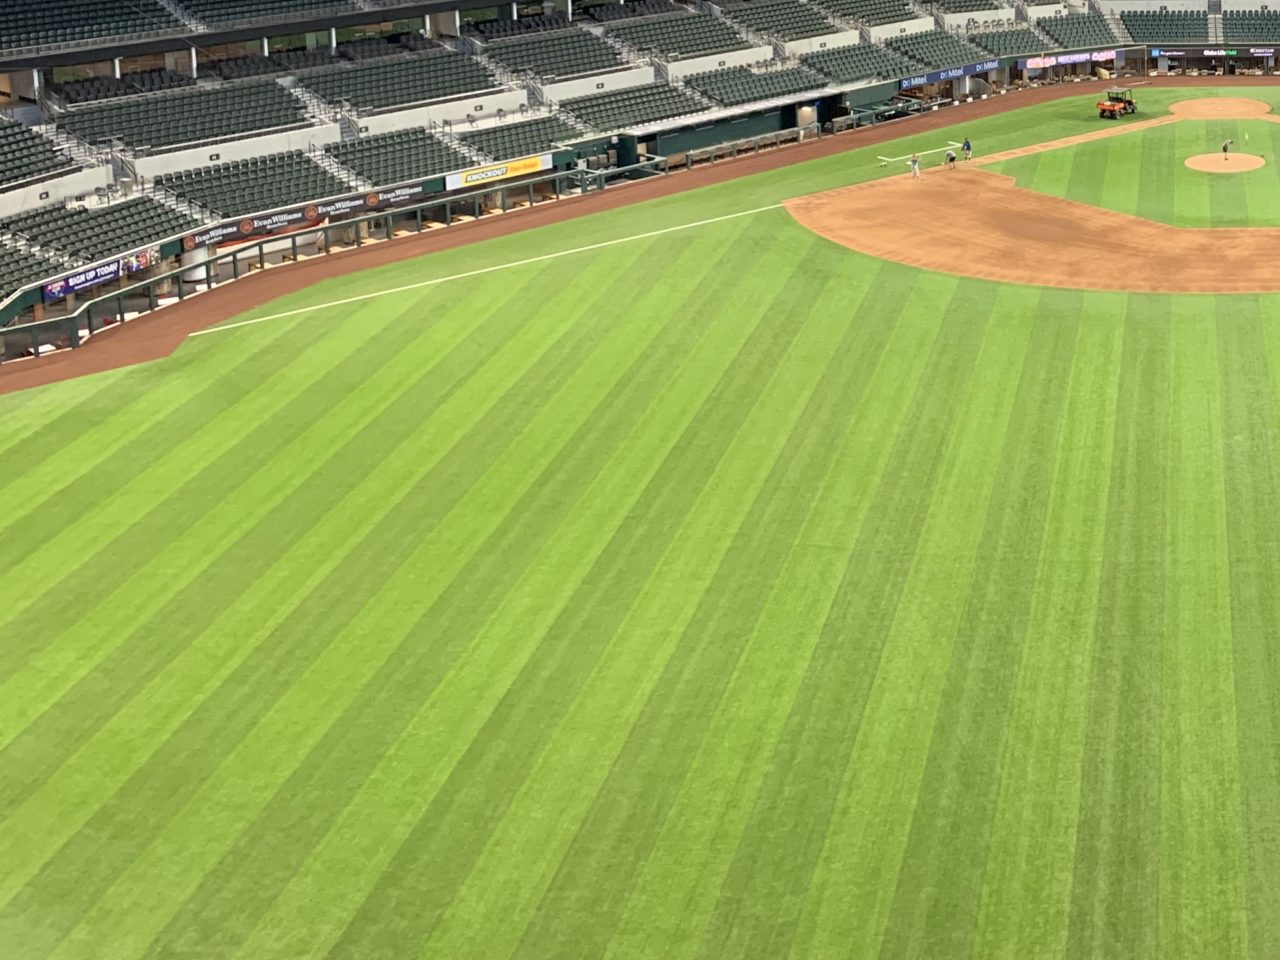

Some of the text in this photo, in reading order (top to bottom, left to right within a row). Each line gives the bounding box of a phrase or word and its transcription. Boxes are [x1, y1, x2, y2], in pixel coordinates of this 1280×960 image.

[948, 67, 963, 77] Mitel
[983, 59, 999, 70] Mitel
[911, 75, 927, 86] Mitel
[465, 167, 508, 183] KNOCKOUT
[378, 186, 423, 201] Evan Williams
[318, 198, 364, 214] Evan Williams
[253, 212, 302, 228] Evan Williams
[195, 226, 237, 243] Evan Williams
[68, 272, 86, 286] SIGN
[86, 270, 96, 281] UP
[96, 262, 119, 277] TODAY
